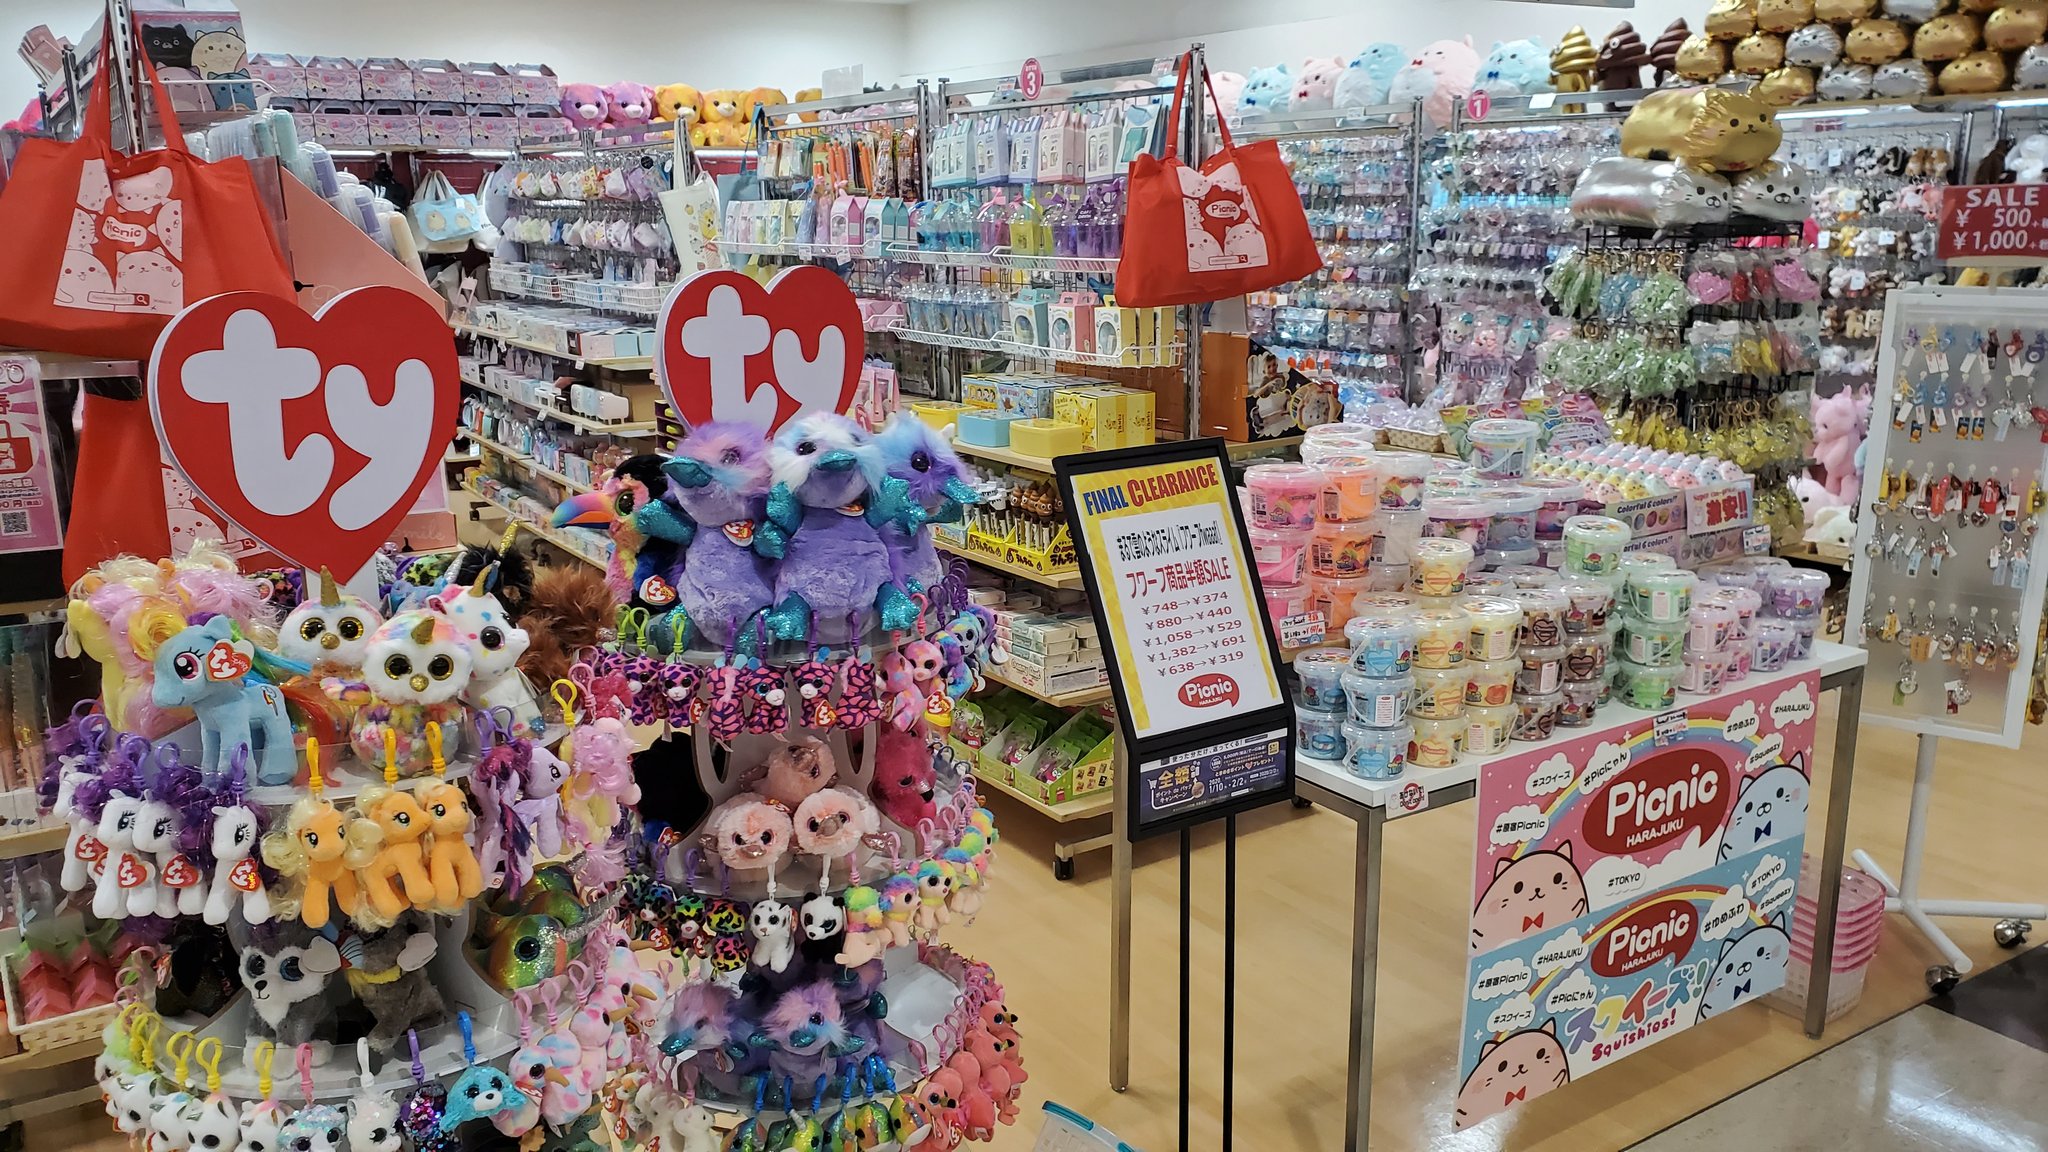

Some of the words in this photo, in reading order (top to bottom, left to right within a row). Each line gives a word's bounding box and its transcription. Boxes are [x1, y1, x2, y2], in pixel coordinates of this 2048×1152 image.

[1027, 71, 1036, 95] 3
[1474, 99, 1482, 117] 1
[1966, 187, 2040, 207] SALE
[1992, 208, 2032, 228] 500
[1953, 230, 2028, 252] ¥1,000
[681, 284, 846, 439] ty
[181, 309, 434, 531] ty
[1083, 485, 1129, 516] FINAL
[210, 648, 237, 678] ty
[1185, 678, 1233, 702] Picnic
[1774, 703, 1811, 713] #HARAJUKU
[1584, 752, 1627, 787] #Picにゃん
[1606, 763, 1718, 837] Picnic
[1626, 817, 1684, 848] HARAJUKU
[1608, 872, 1640, 887] #TOKYO
[1751, 863, 1781, 889] #TOKYO
[1704, 903, 1744, 933] #ゆめふわ
[1607, 910, 1690, 966] Picnic
[1537, 947, 1583, 965] #HARAJUKU
[1621, 948, 1664, 972] HARAJUKU
[1551, 989, 1594, 1006] #Picにゃん
[1565, 958, 1709, 1054] スクイーズ!
[1591, 1008, 1676, 1061] Squishies!
